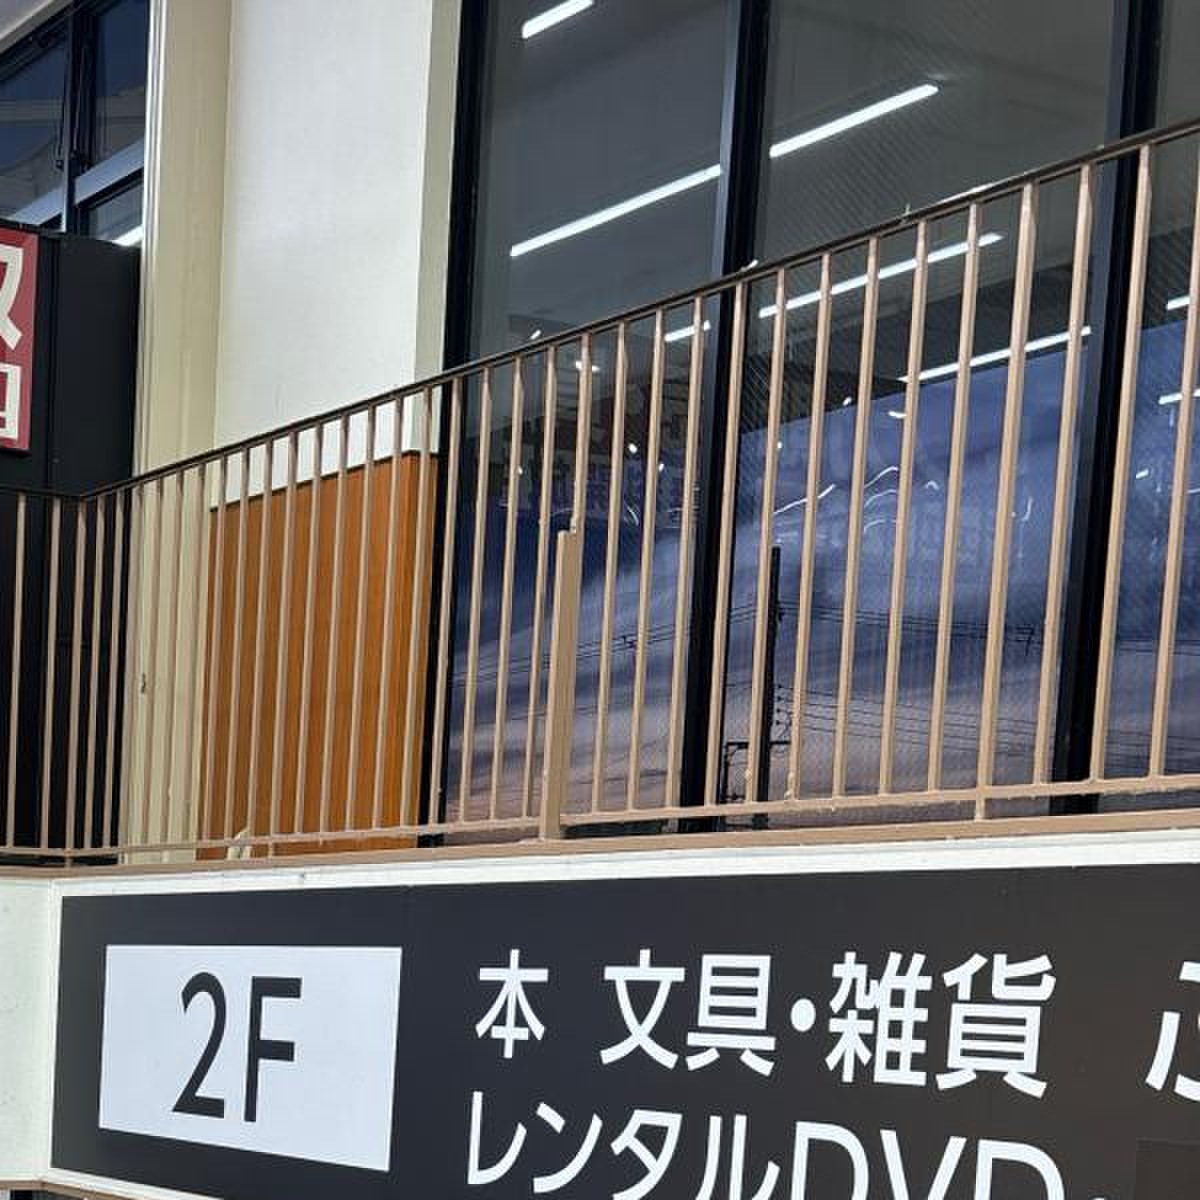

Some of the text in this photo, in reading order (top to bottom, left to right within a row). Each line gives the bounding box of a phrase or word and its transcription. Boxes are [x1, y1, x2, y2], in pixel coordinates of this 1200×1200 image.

[171, 972, 303, 1123] 2F
[475, 948, 549, 1059] 本
[600, 948, 1057, 1098] 文具・雑貨
